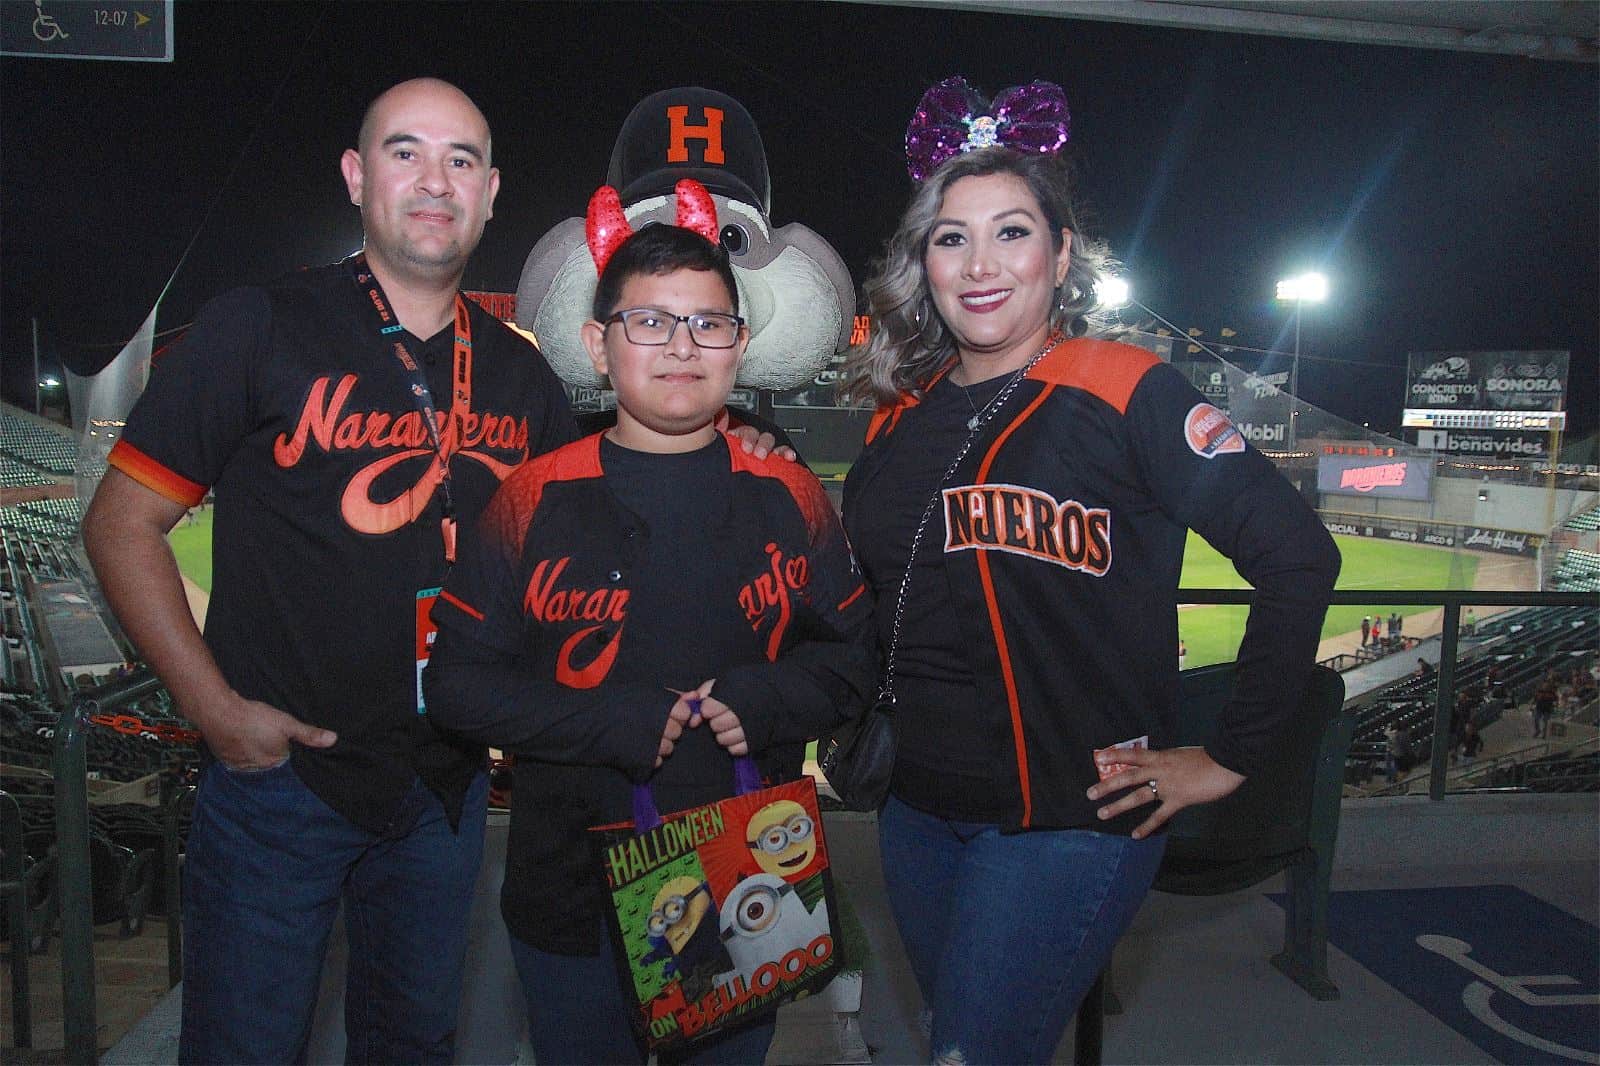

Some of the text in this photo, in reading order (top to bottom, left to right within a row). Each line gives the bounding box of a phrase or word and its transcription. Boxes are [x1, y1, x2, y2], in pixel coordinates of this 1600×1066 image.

[94, 9, 128, 26] 12-07
[666, 105, 724, 164] H
[1412, 384, 1478, 394] CONCRETOS
[1486, 378, 1562, 392] SONORA
[1237, 423, 1285, 441] Mobil
[273, 373, 529, 535] Naraeros
[1449, 435, 1543, 455] benavides
[608, 804, 726, 886] HALLOWEEN
[649, 933, 834, 1040] ON BELLOOO
